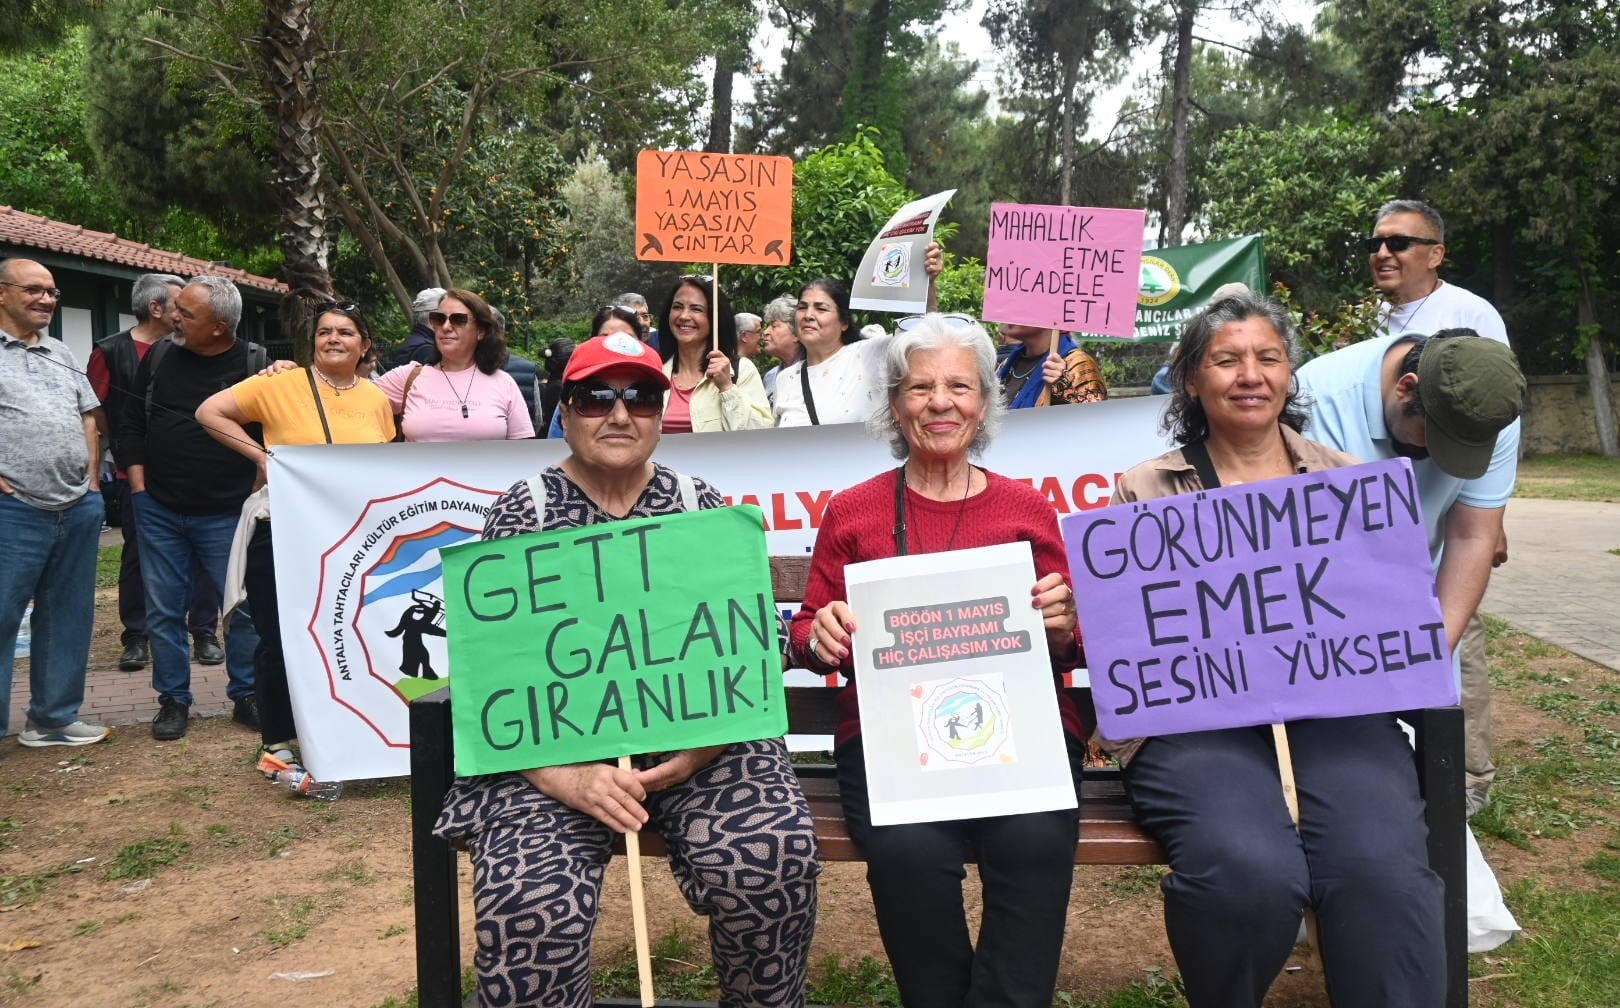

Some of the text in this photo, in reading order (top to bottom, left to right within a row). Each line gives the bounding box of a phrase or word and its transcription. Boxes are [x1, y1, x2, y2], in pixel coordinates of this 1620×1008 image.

[665, 188, 757, 212] 1 MAYIS
[988, 260, 1104, 298] MÜCADELE
[1063, 247, 1125, 274] ETME
[1135, 308, 1192, 323] ANCILAR
[1082, 468, 1419, 579] GÖRÜNMEYEN
[333, 500, 490, 681] ANTALYA TAHTACILARI KÜLTÜR EĞİTİM DAYANIŞ
[464, 523, 662, 622] GETT
[1141, 557, 1346, 647] EMEK
[545, 593, 770, 680] GALAN
[889, 603, 1005, 629] BÖÖÖN 1 MAYIS
[900, 620, 999, 646] İŞÇİ BAYRAMI
[878, 635, 1022, 666] HİÇ ÇALIŞASIM YOK
[1108, 622, 1444, 716] SESİNİ YÜKSELT
[481, 659, 769, 750] GIRANLIK!
